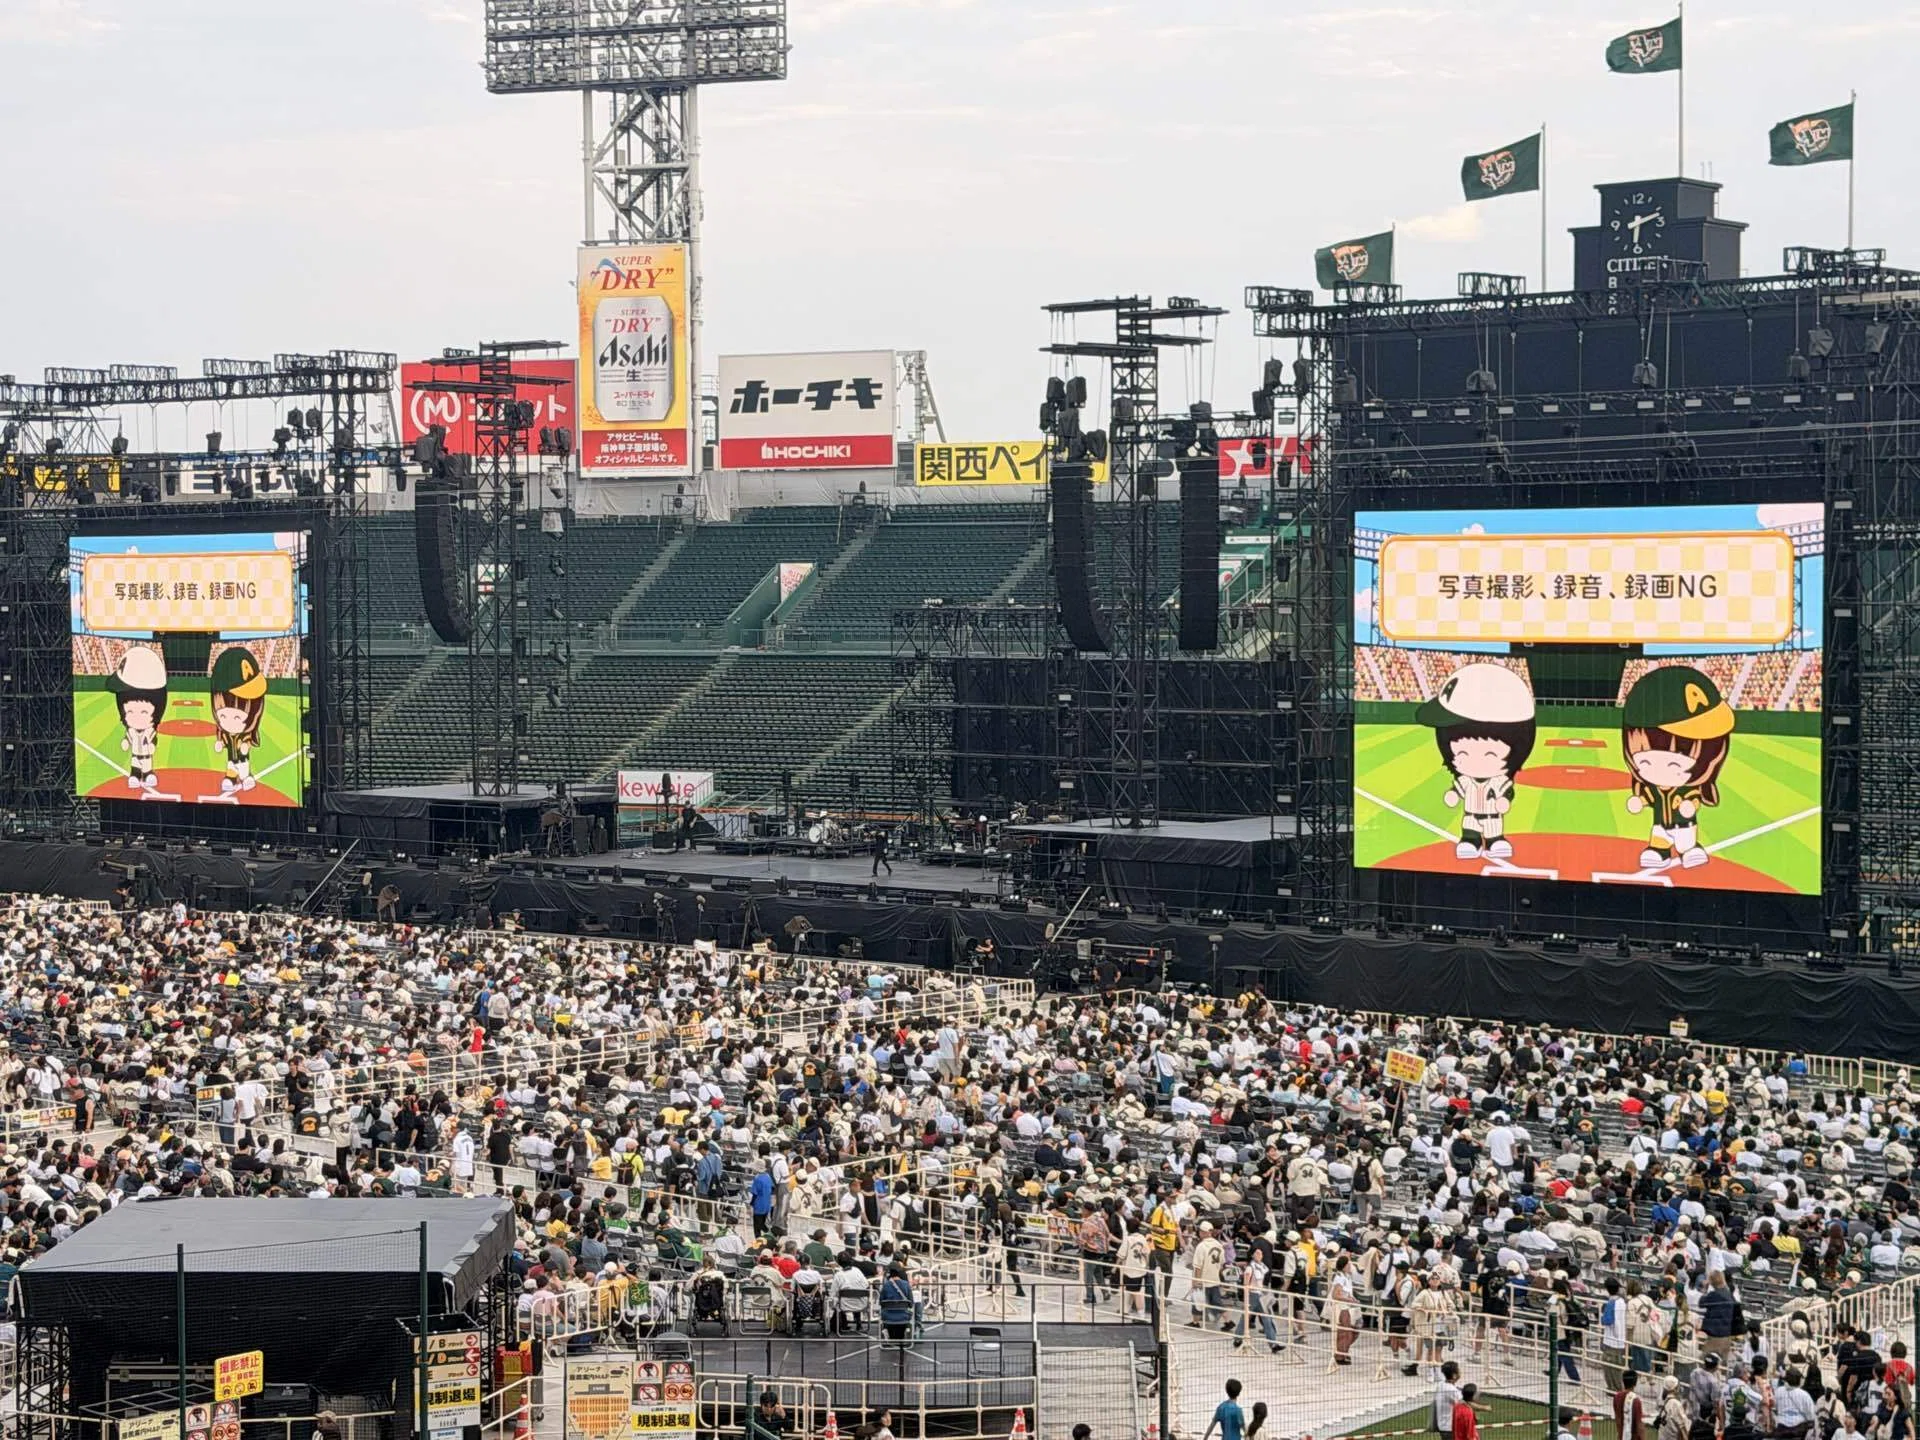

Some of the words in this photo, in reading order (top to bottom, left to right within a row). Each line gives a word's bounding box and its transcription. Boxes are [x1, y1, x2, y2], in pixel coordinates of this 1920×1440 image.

[1632, 193, 1644, 204] 12
[1610, 220, 1620, 231] 9
[1632, 243, 1643, 254] 6
[614, 255, 653, 266] SUPER
[621, 308, 647, 316] SUPER
[599, 333, 667, 368] Asahi
[626, 368, 642, 383] 生
[729, 377, 883, 414] ホーチキ
[600, 443, 668, 454] 阪神甲子園球場の
[774, 444, 851, 459] HOCHIKI
[594, 454, 678, 464] オフィシャルビールです。
[920, 445, 1047, 483] 関西ペイ
[114, 582, 257, 600] 写真撮影、録音、録画NG
[1438, 573, 1718, 600] 写真撮影、録音、録画NG
[1684, 682, 1709, 714] A
[219, 1355, 260, 1374] 撮影禁止
[637, 1413, 690, 1428] 規制退場
